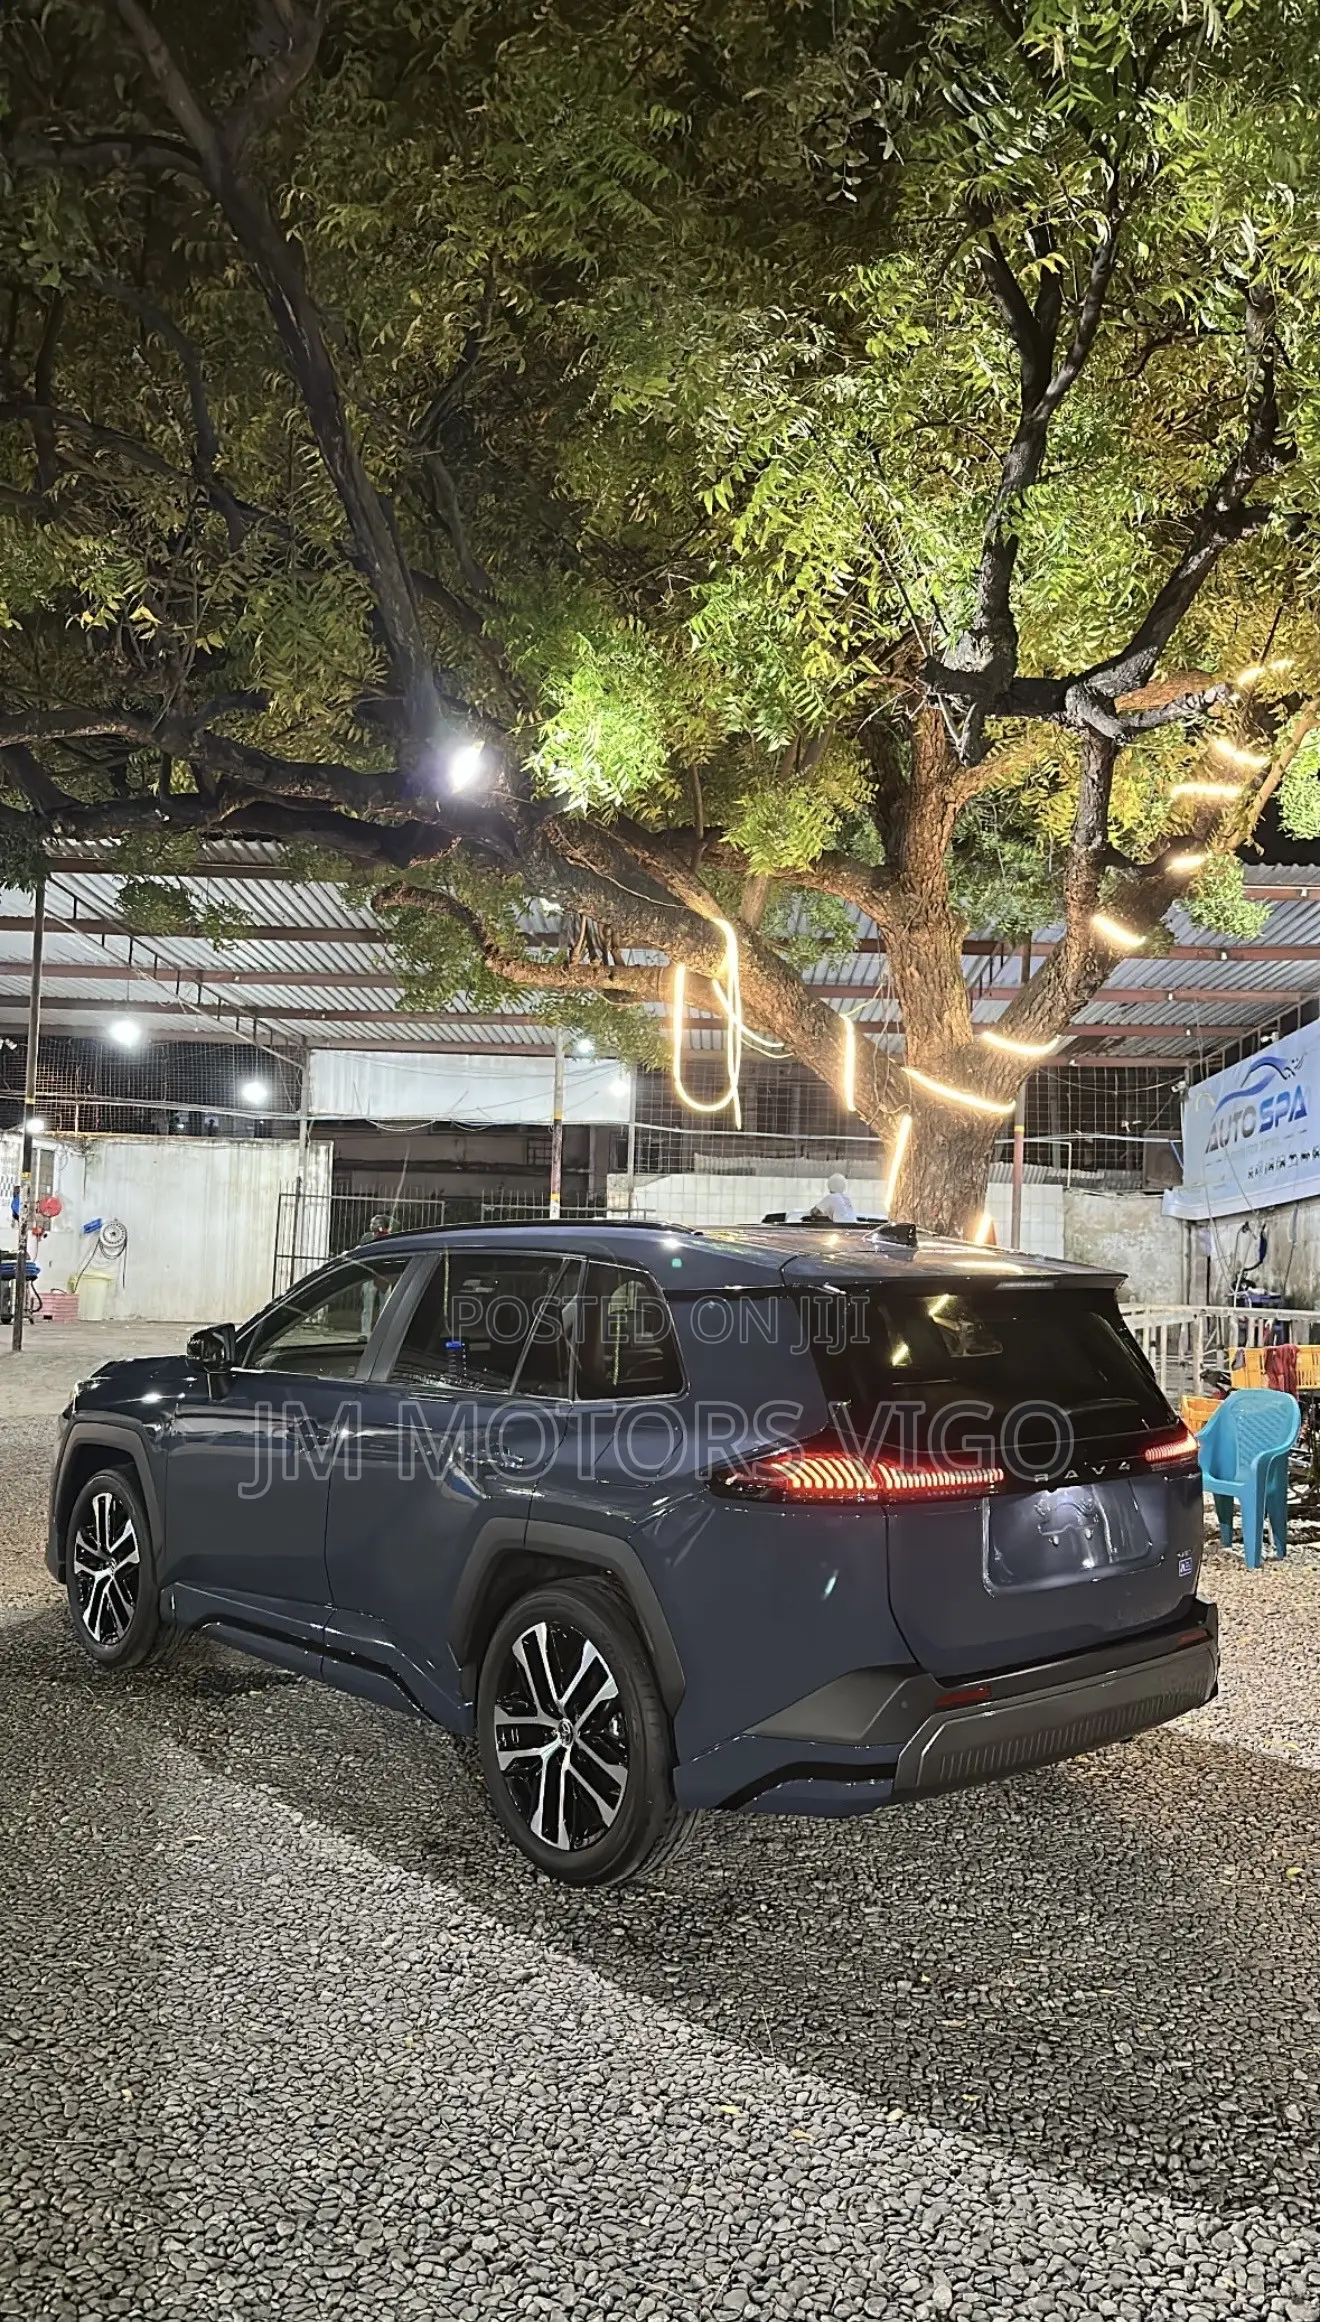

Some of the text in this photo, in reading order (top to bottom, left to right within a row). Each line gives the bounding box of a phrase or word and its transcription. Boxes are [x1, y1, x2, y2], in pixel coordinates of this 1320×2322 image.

[1205, 1105, 1257, 1154] AUTO
[1258, 1085, 1308, 1133] SPA
[1034, 1461, 1131, 1482] RAV4
